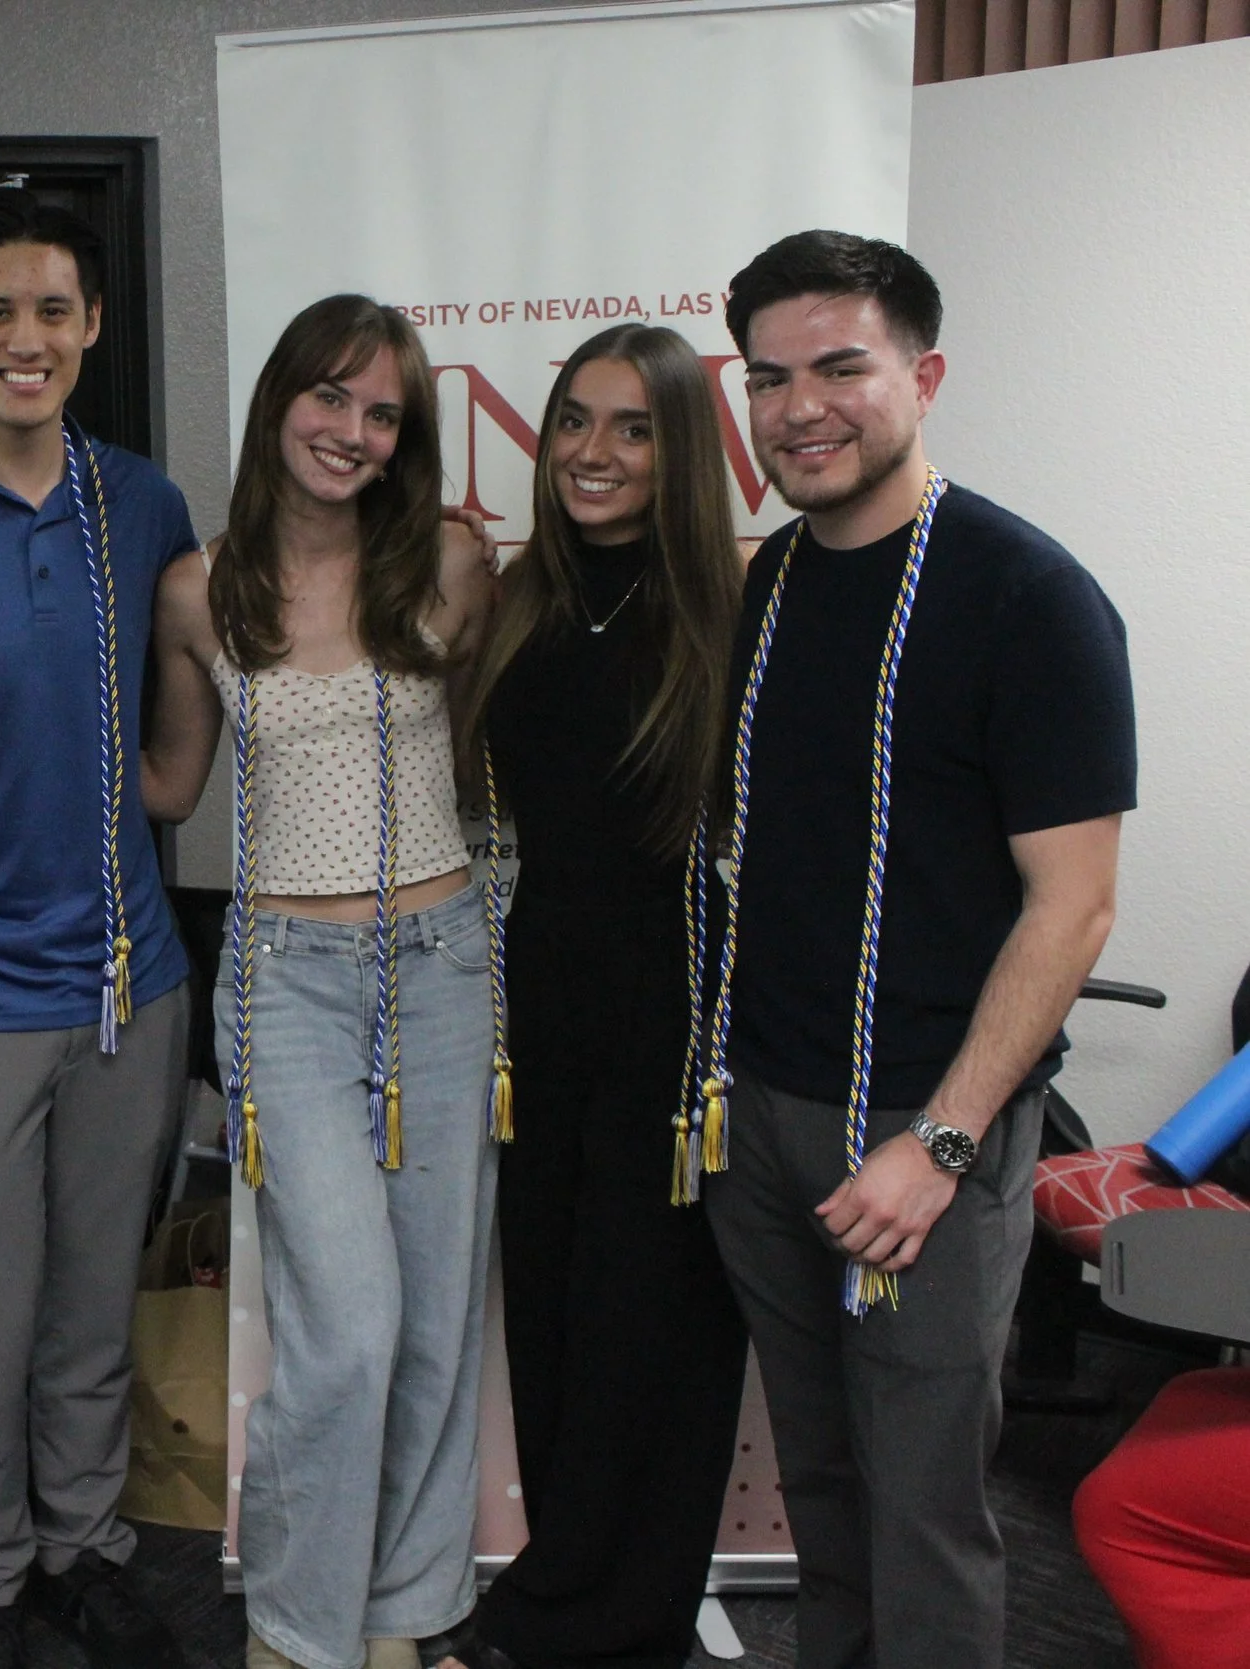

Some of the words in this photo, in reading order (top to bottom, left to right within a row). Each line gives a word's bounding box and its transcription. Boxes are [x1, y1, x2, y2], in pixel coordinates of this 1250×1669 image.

[478, 301, 515, 324] OF
[524, 295, 651, 322] NEVADA,
[660, 292, 713, 316] LAS
